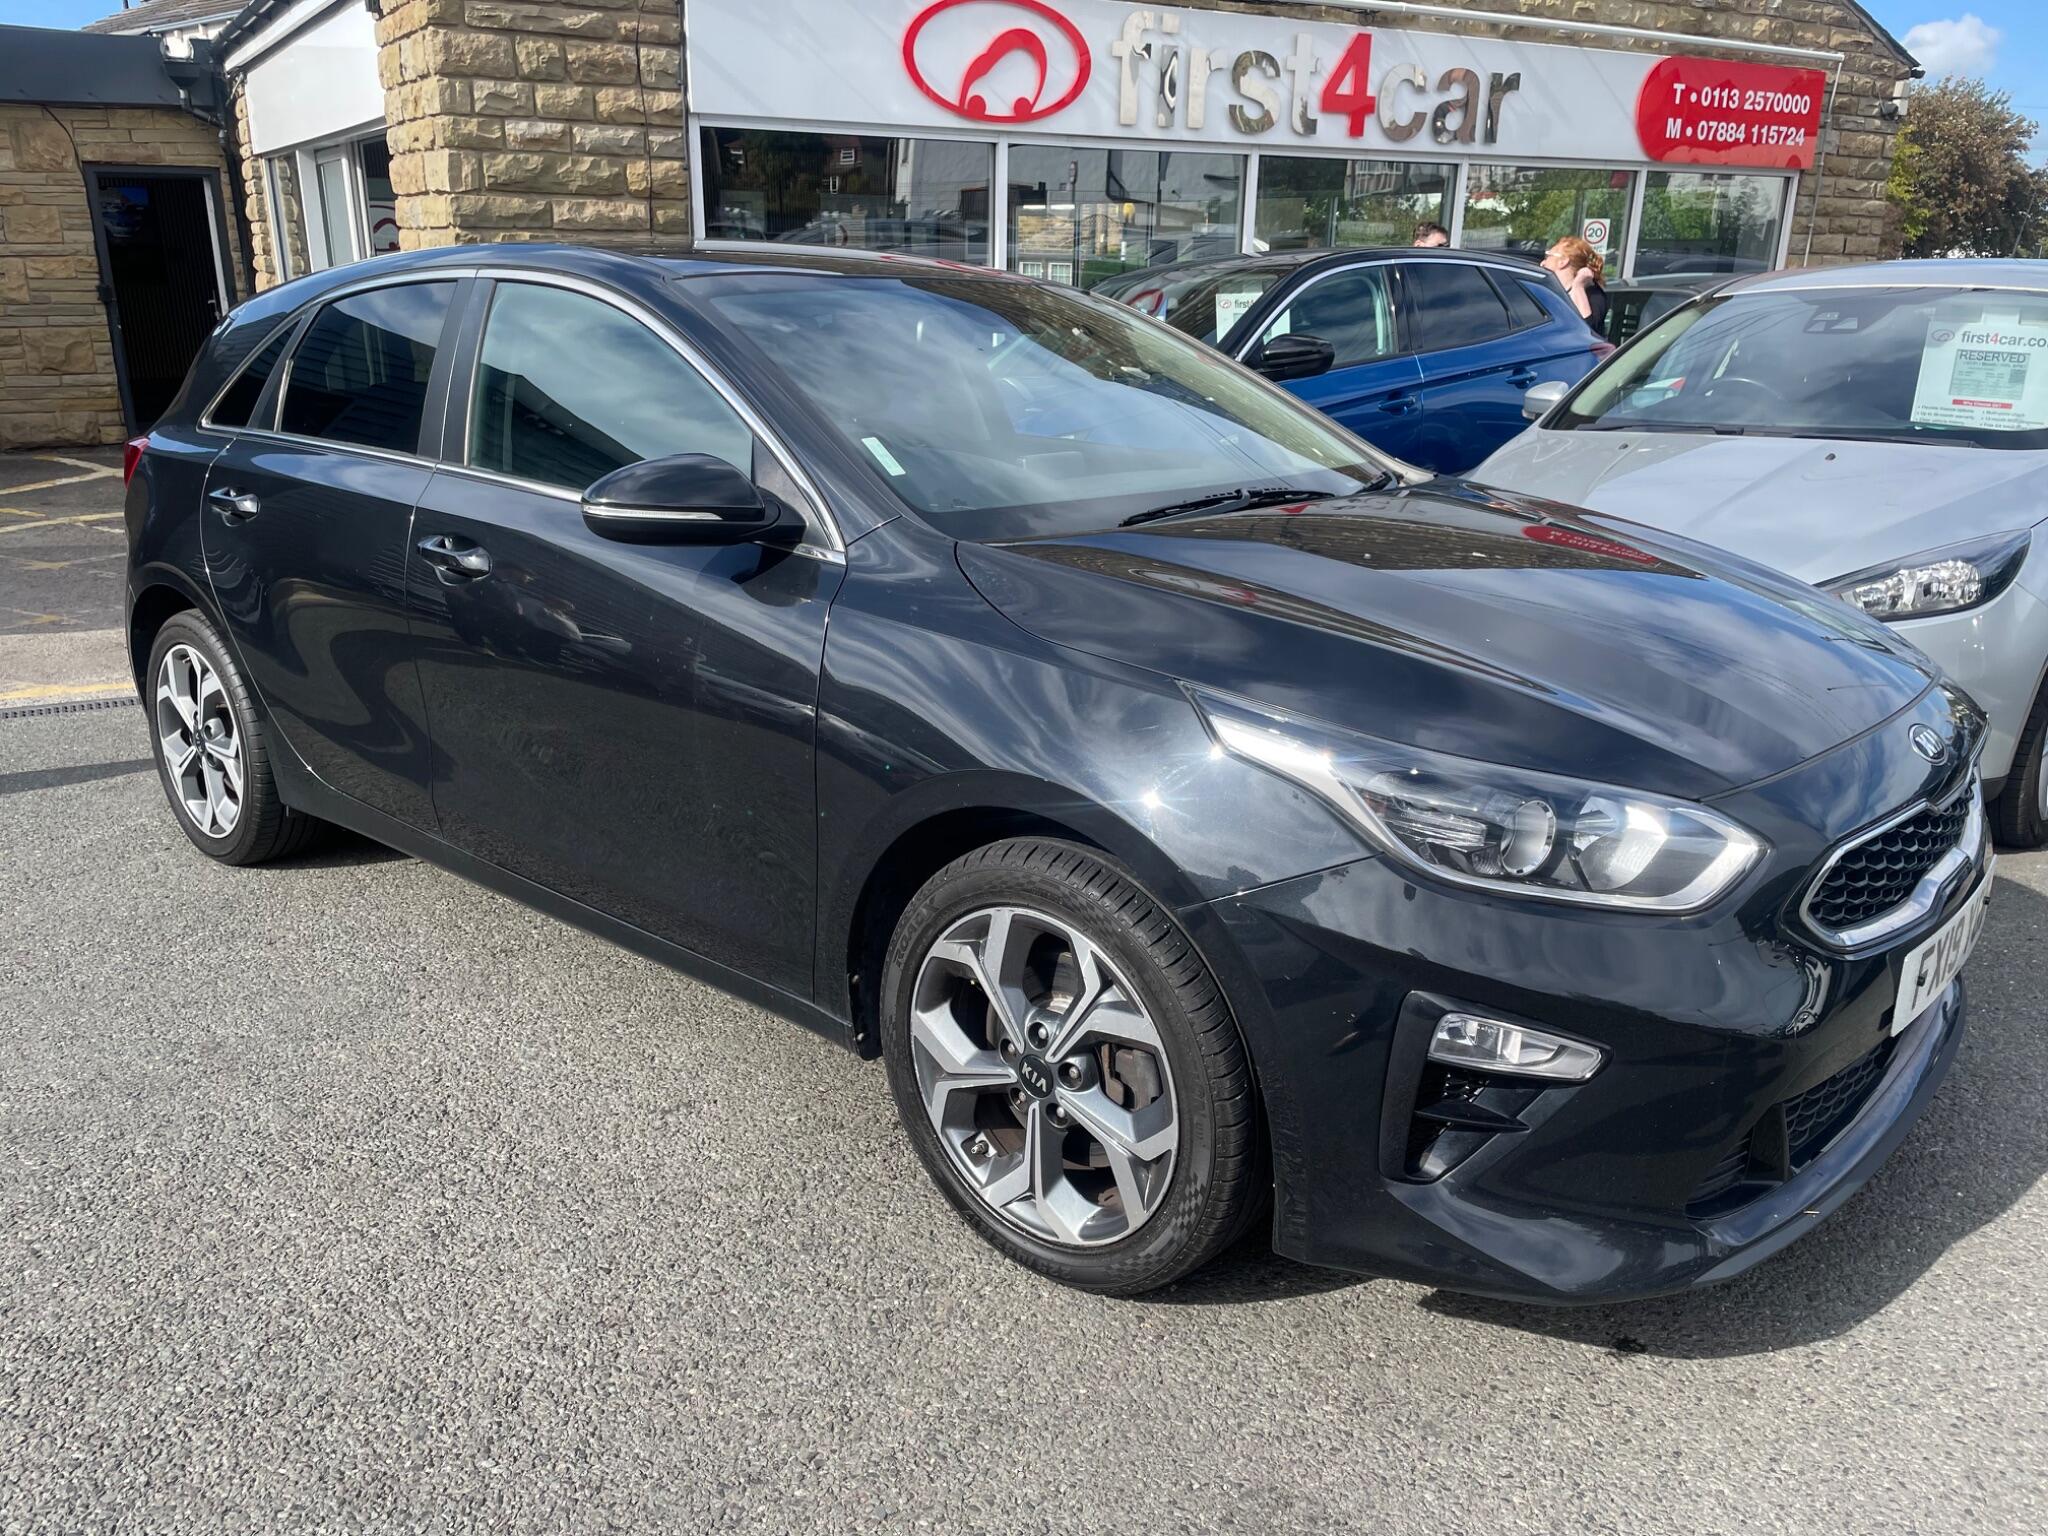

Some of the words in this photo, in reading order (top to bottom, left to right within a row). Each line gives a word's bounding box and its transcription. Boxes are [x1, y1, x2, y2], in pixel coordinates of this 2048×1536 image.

[1112, 10, 1521, 145] first4car
[1673, 83, 1686, 105] T
[1701, 86, 1740, 109] 0113
[1743, 90, 1811, 115] 2570000
[1665, 118, 1682, 139] M
[1697, 121, 1745, 143] 07884
[1751, 124, 1806, 146] 115724
[1588, 227, 1602, 238] 20
[1959, 350, 2026, 364] RESERVED
[1021, 1061, 1047, 1093] KIA
